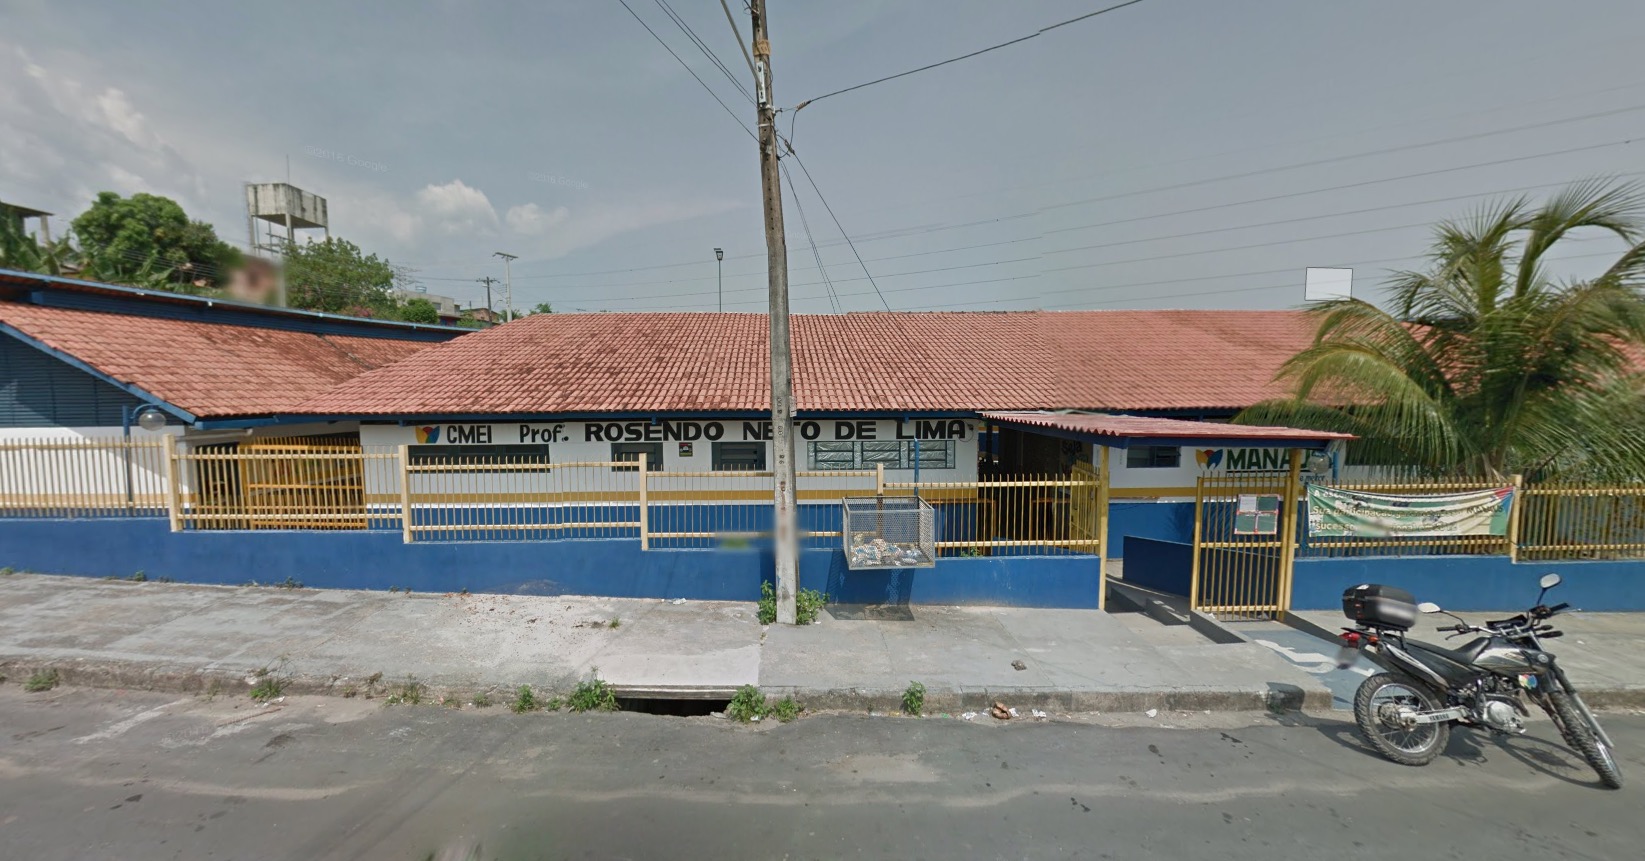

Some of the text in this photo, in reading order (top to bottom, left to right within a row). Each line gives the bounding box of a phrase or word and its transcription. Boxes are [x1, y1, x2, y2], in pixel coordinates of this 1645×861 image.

[446, 424, 492, 444] CMEI
[584, 421, 725, 442] ROSENDO
[743, 421, 821, 441] NEO
[834, 421, 877, 440] DE
[896, 420, 966, 440] LIMA
